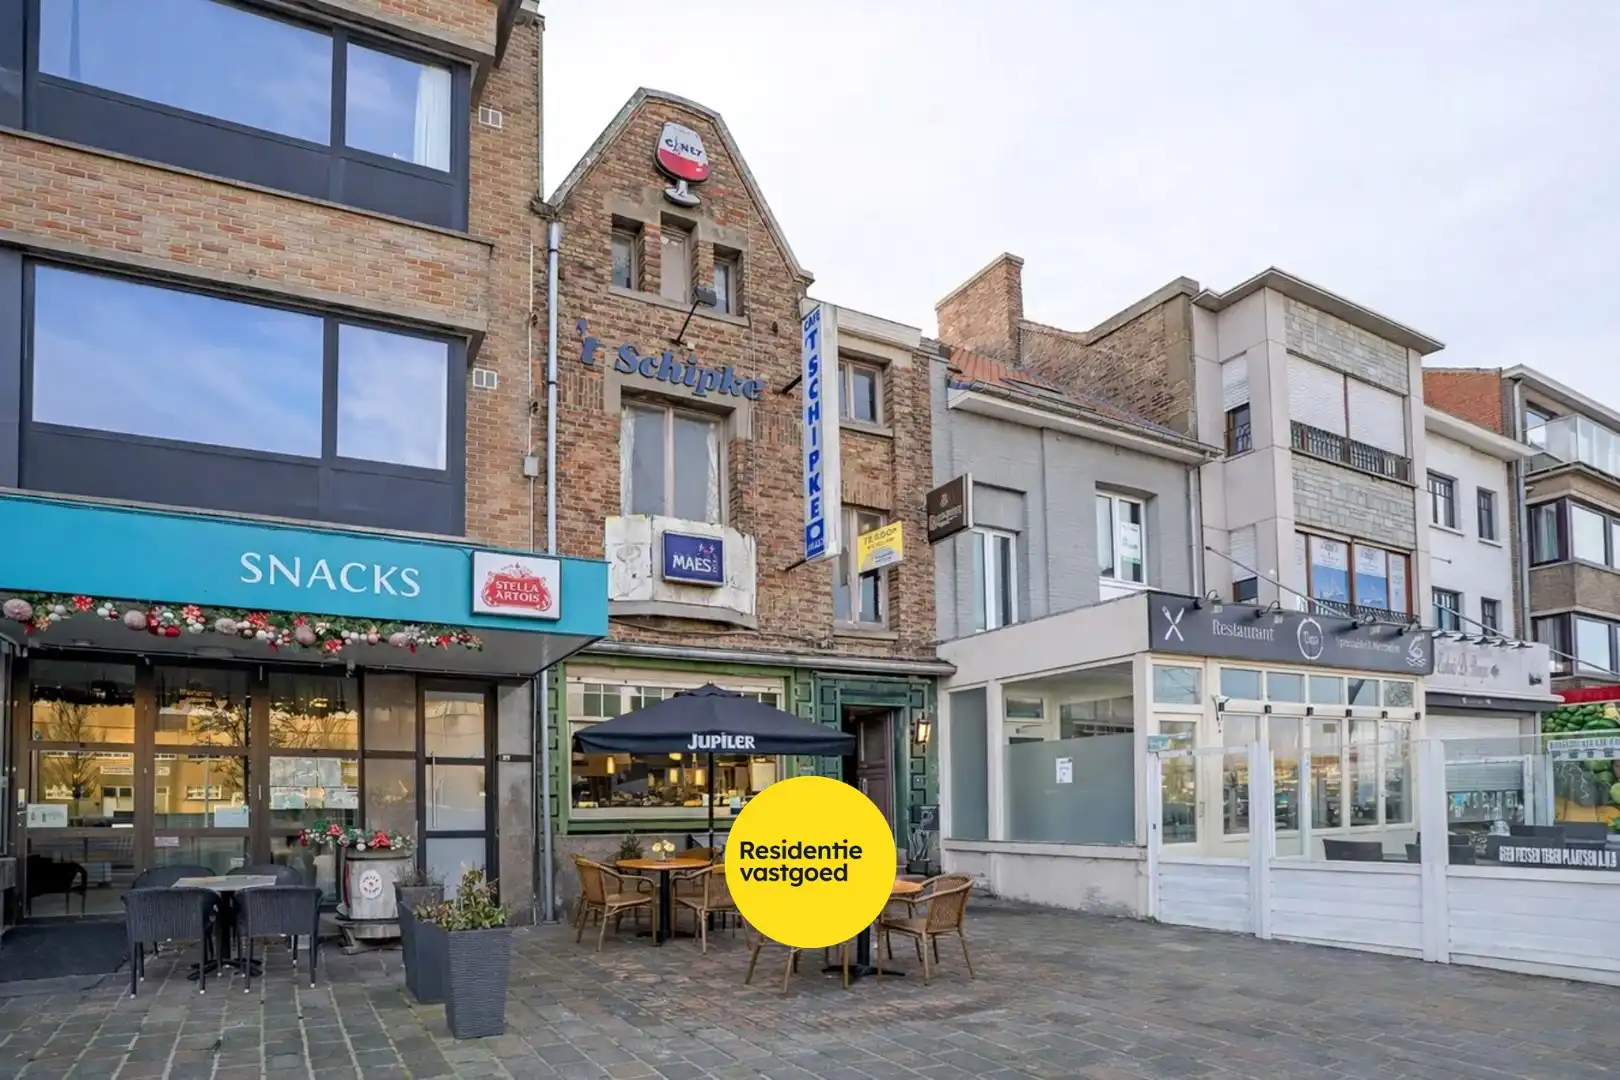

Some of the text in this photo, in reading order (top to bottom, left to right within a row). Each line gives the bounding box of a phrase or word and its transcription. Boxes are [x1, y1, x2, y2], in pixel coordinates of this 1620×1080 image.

[614, 343, 767, 400] Schipke
[672, 554, 712, 573] MAES
[240, 552, 421, 597] SNACKS
[495, 581, 538, 593] STELLA
[495, 590, 540, 603] ARTOIS
[1212, 619, 1275, 641] Restaurant
